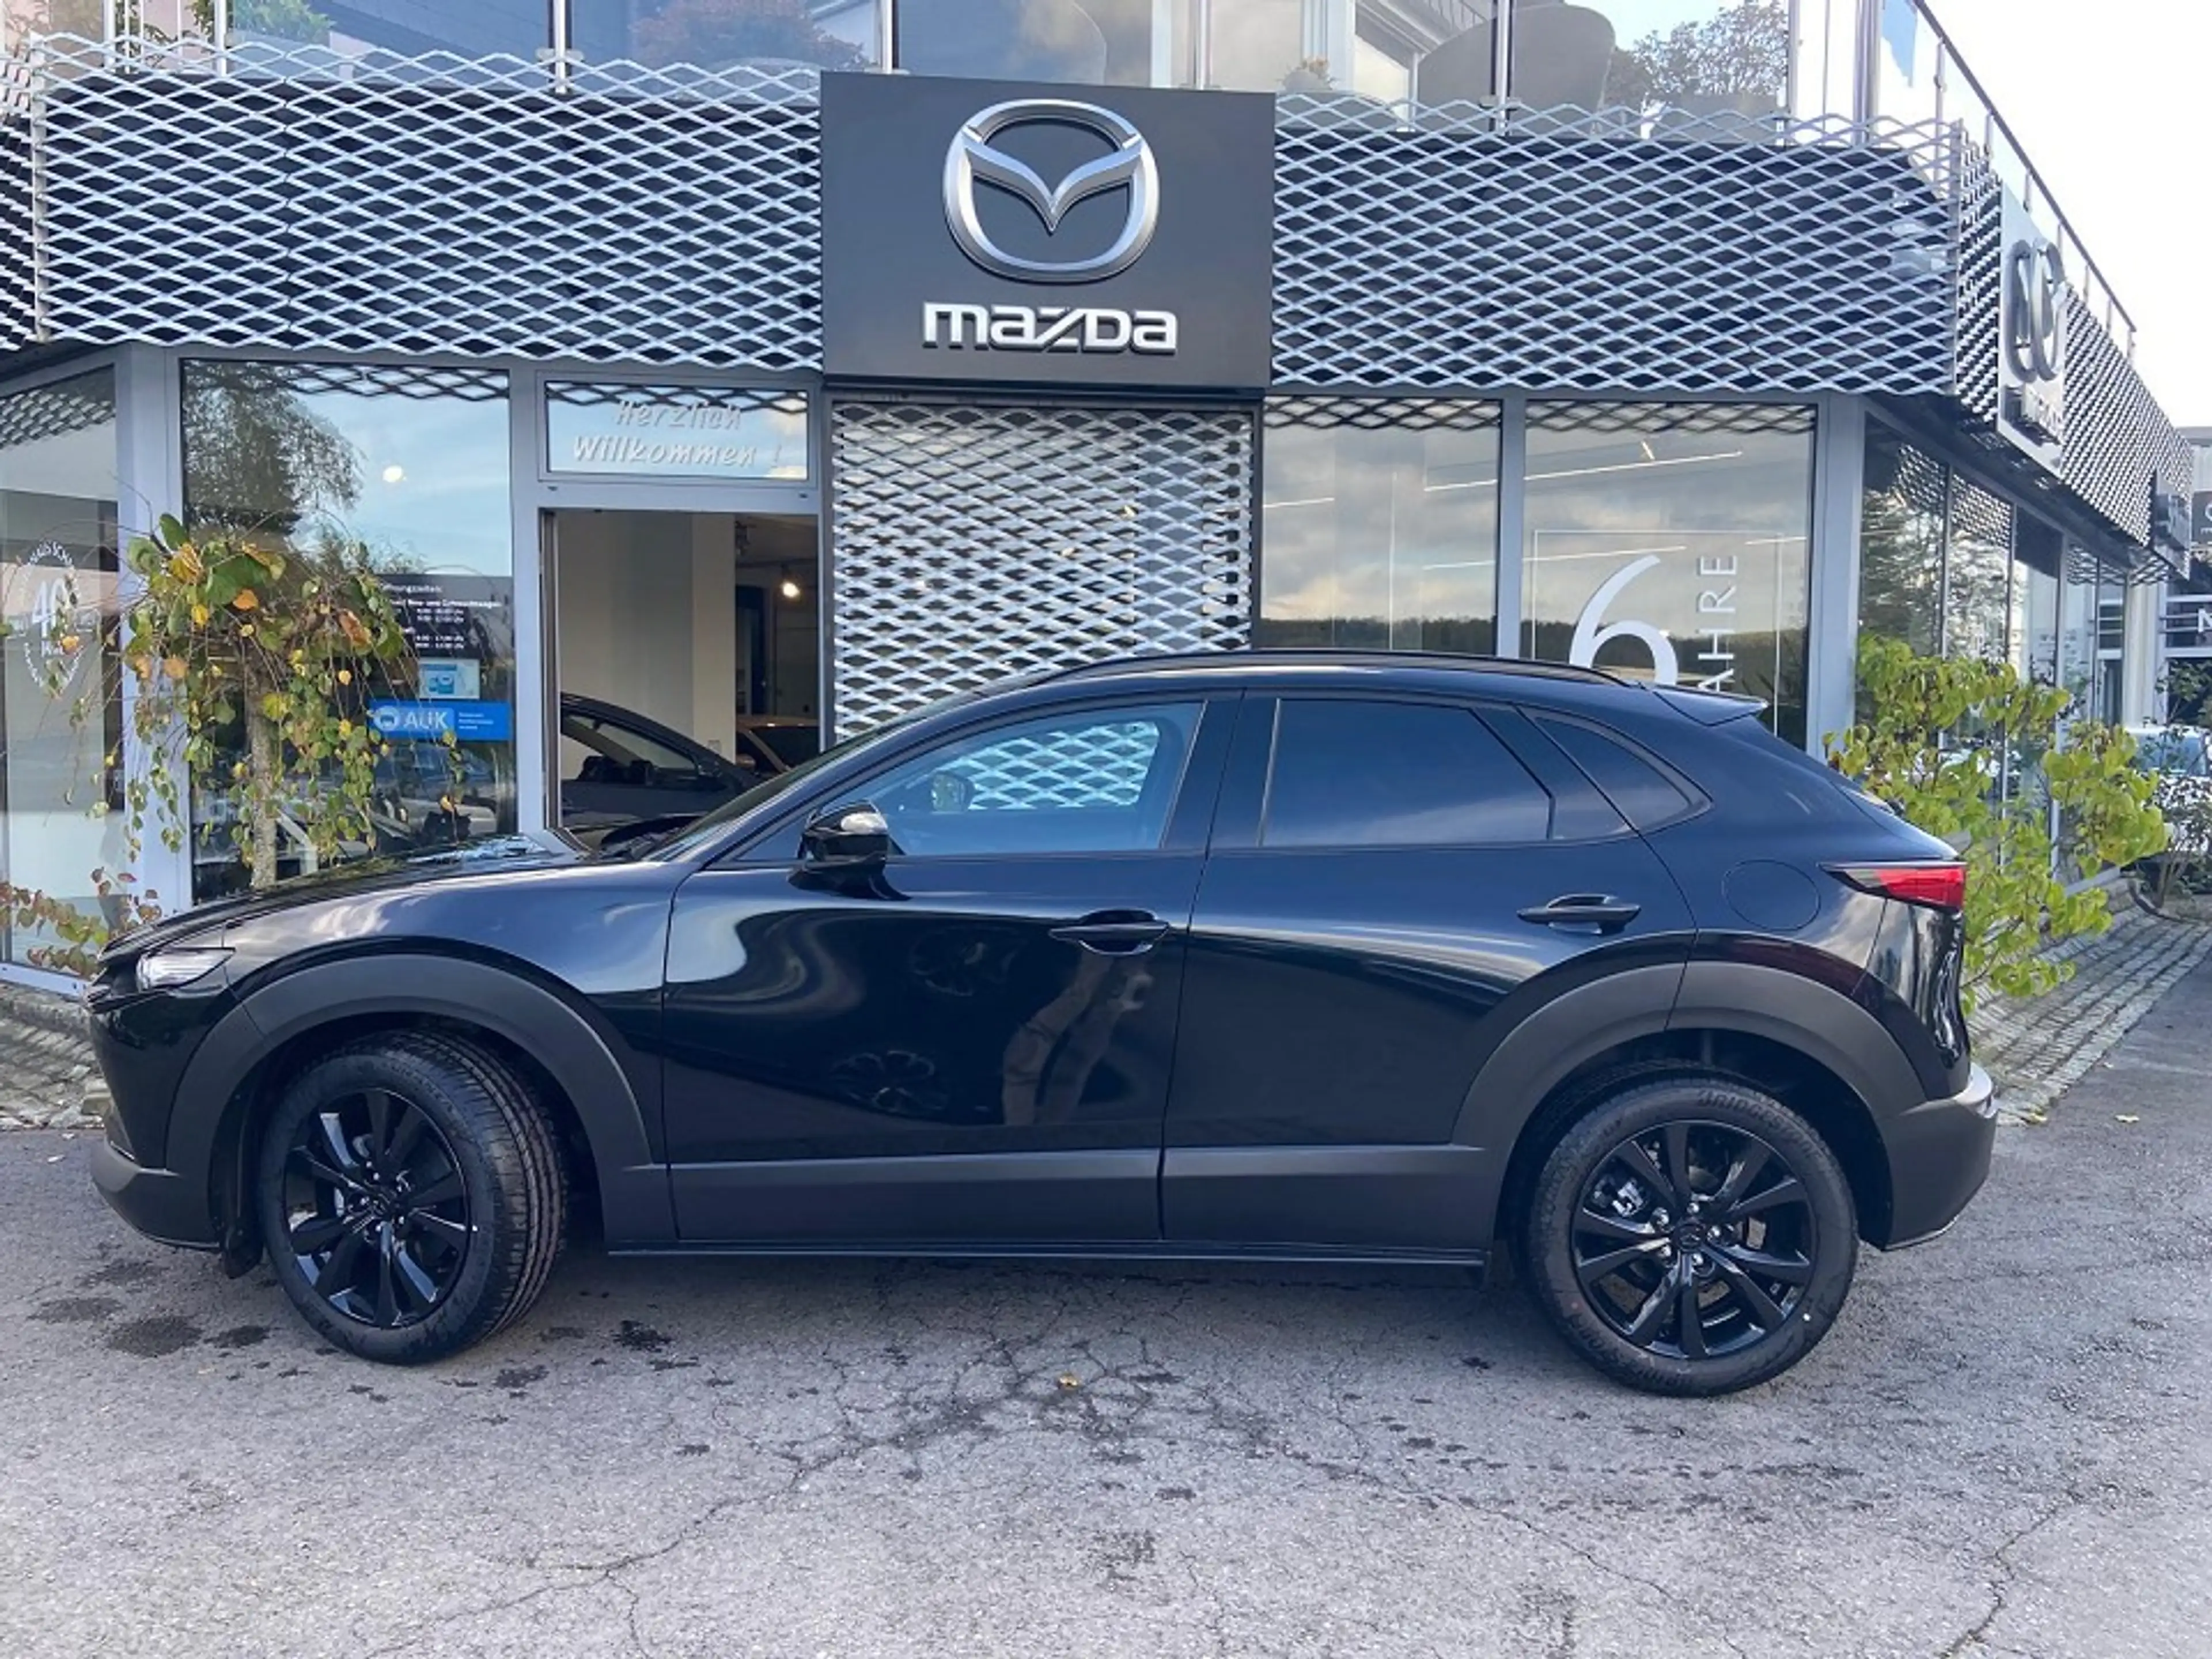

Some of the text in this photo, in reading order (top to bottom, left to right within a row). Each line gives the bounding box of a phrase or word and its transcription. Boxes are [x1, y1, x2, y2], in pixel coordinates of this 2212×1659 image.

[923, 301, 1177, 355] mazda
[616, 400, 743, 430] Herzlich
[573, 435, 756, 466] Willkommen
[1697, 555, 1738, 692] AHRE
